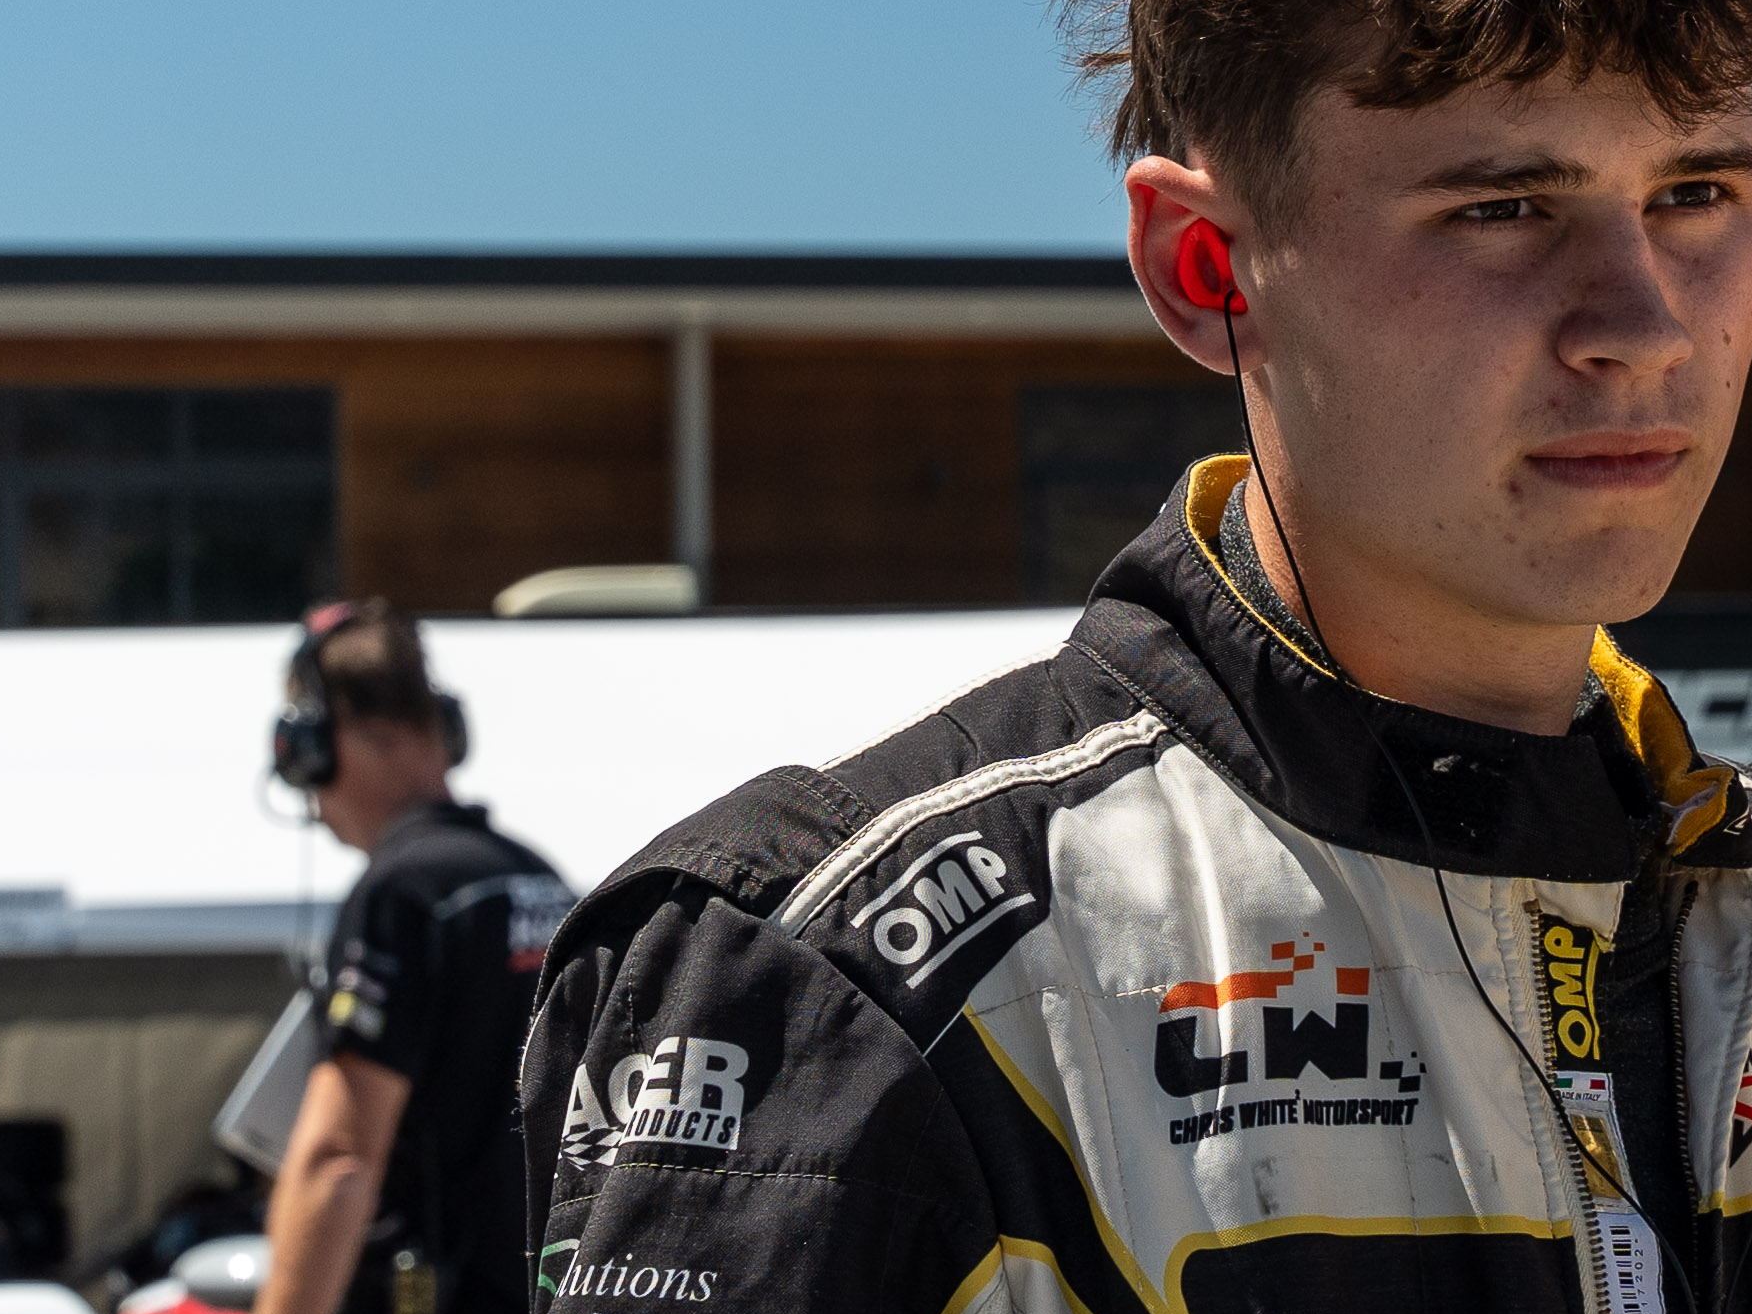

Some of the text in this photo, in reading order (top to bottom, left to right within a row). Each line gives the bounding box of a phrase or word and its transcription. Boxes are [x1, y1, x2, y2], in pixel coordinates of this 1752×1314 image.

[874, 846, 1007, 966] OMP
[1544, 925, 1593, 1059] OMP
[1169, 1098, 1419, 1145] CHRIS WHITE MOTORSPORT
[552, 1249, 718, 1302] lutions
